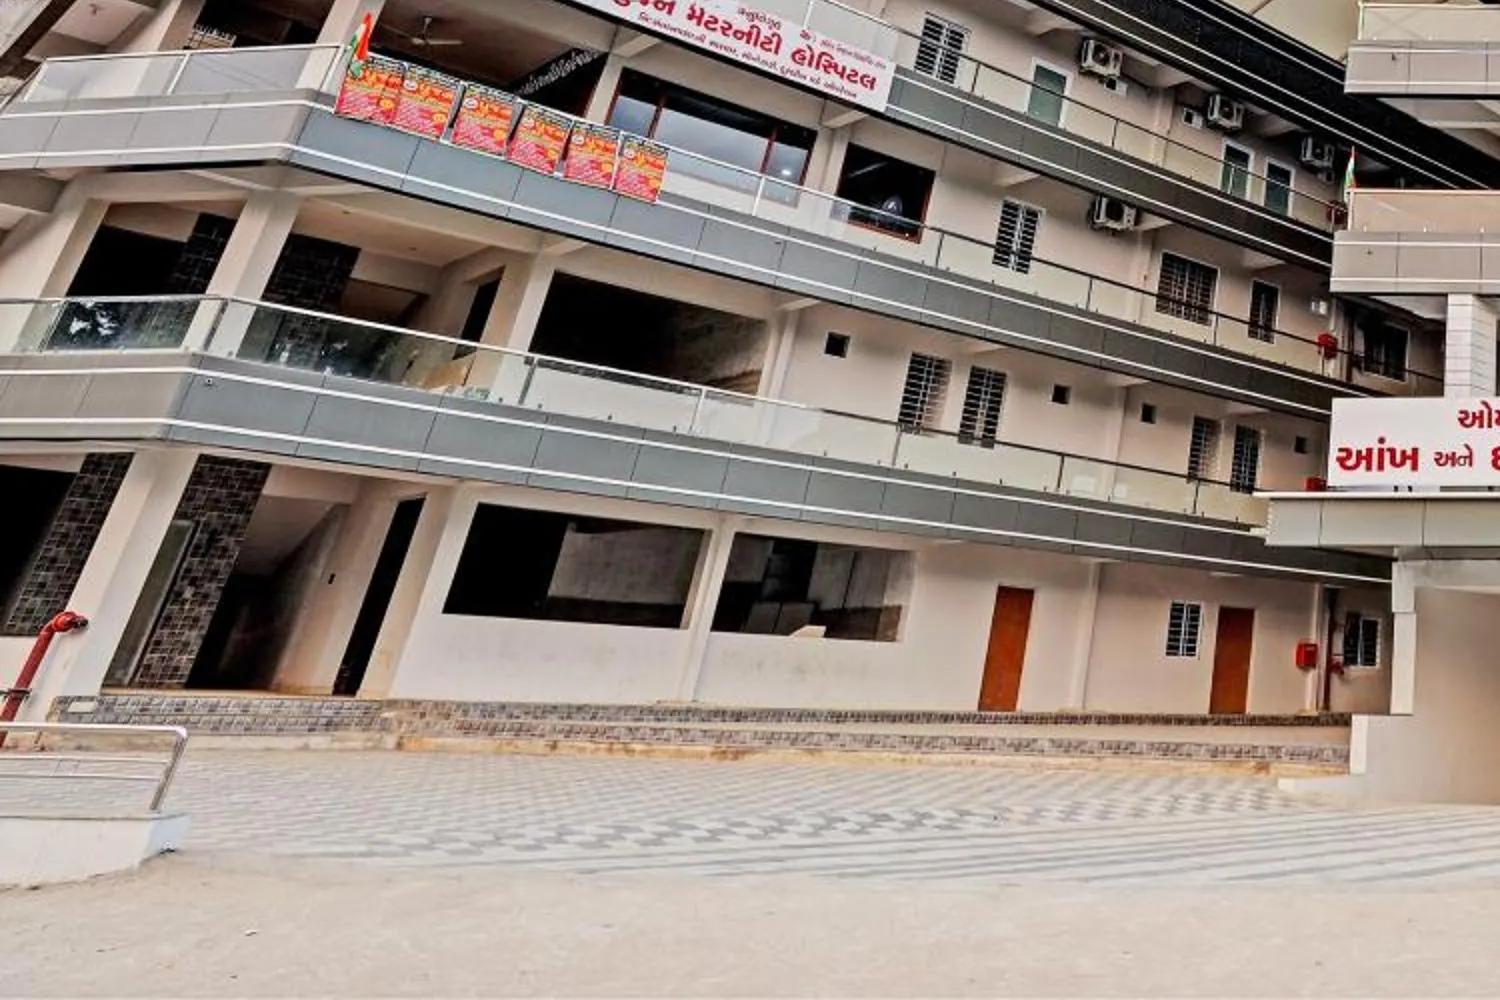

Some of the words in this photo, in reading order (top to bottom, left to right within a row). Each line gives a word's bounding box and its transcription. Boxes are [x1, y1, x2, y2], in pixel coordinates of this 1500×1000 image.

[791, 44, 877, 90] હોસ્પિટલ
[1335, 436, 1420, 473] આંખ
[1434, 444, 1474, 468] અને
